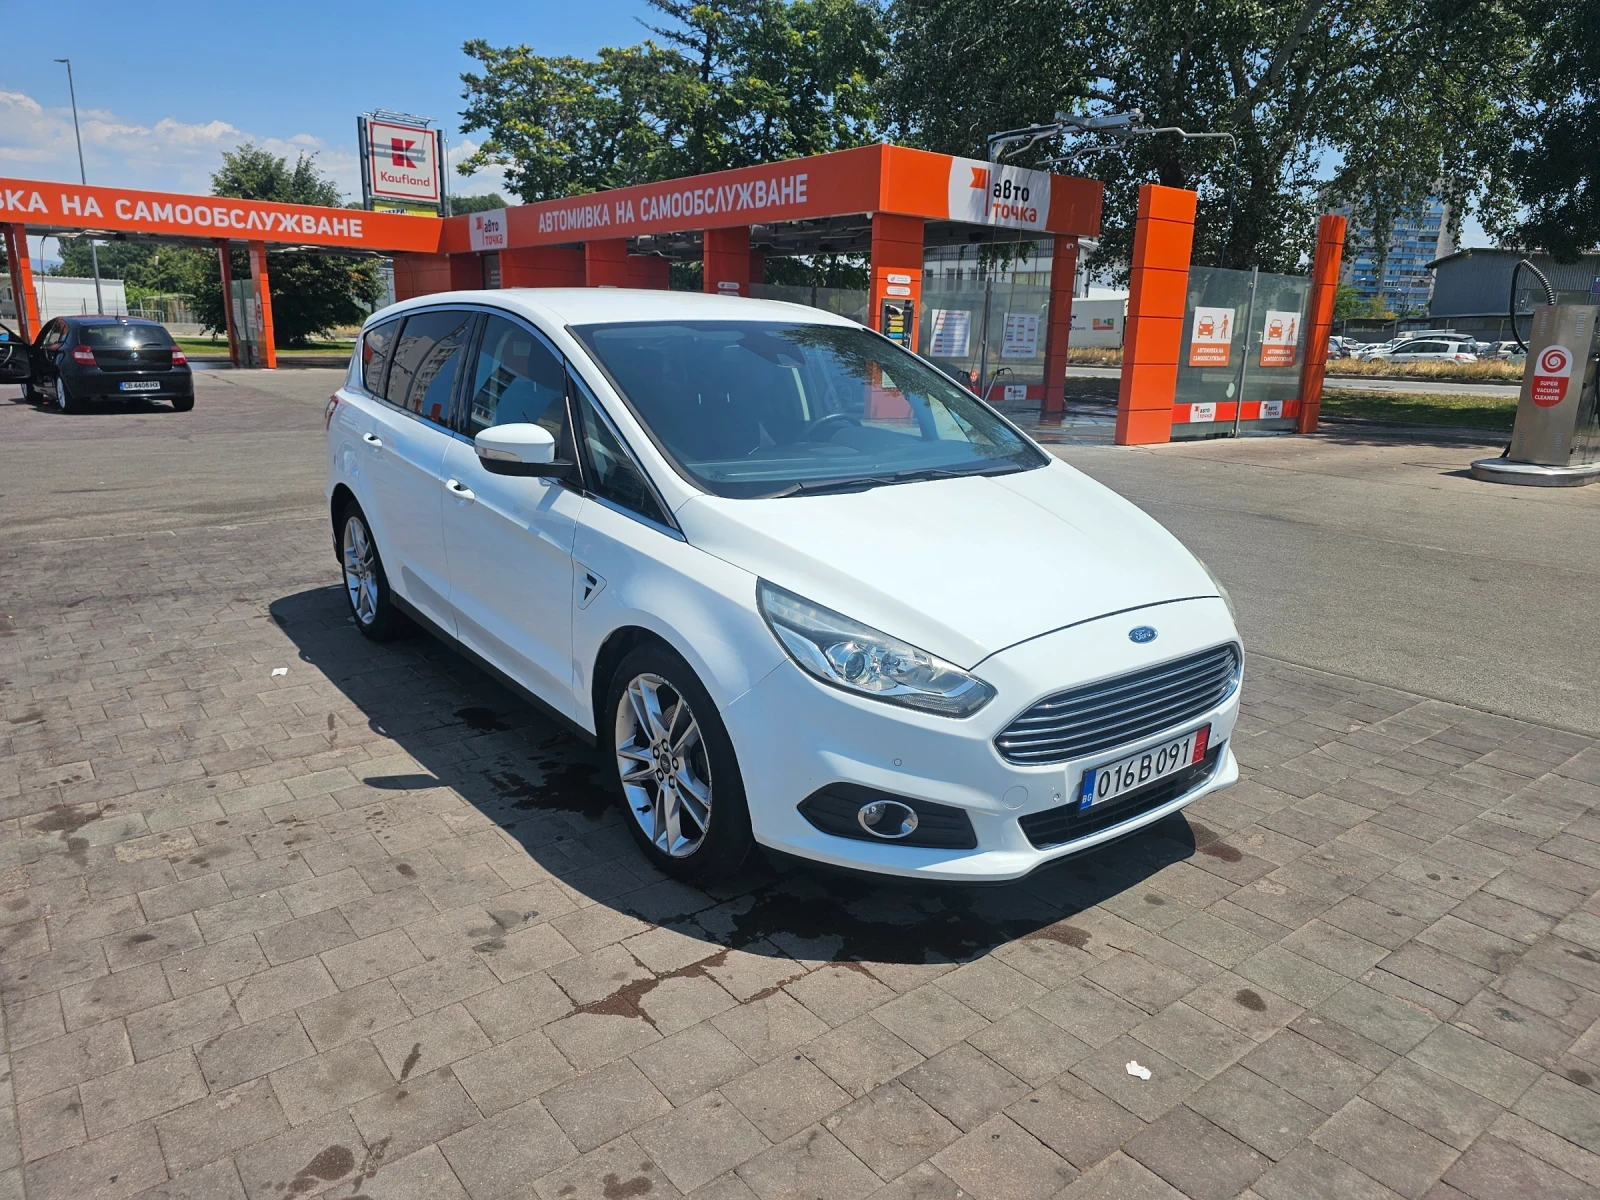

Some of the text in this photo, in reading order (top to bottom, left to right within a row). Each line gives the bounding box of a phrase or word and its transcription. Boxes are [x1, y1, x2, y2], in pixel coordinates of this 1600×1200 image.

[380, 171, 430, 187] Kaufland
[538, 173, 808, 233] АВТОМИВКА НА САМООБСЛУЖВАНЕ
[0, 188, 364, 238] КА НА САМООБСЛУЖВАНЕ
[992, 203, 1037, 223] точка
[485, 234, 503, 246] точка
[1134, 629, 1153, 641] Ford
[1097, 738, 1190, 798] 016B091
[1082, 793, 1093, 803] BG
